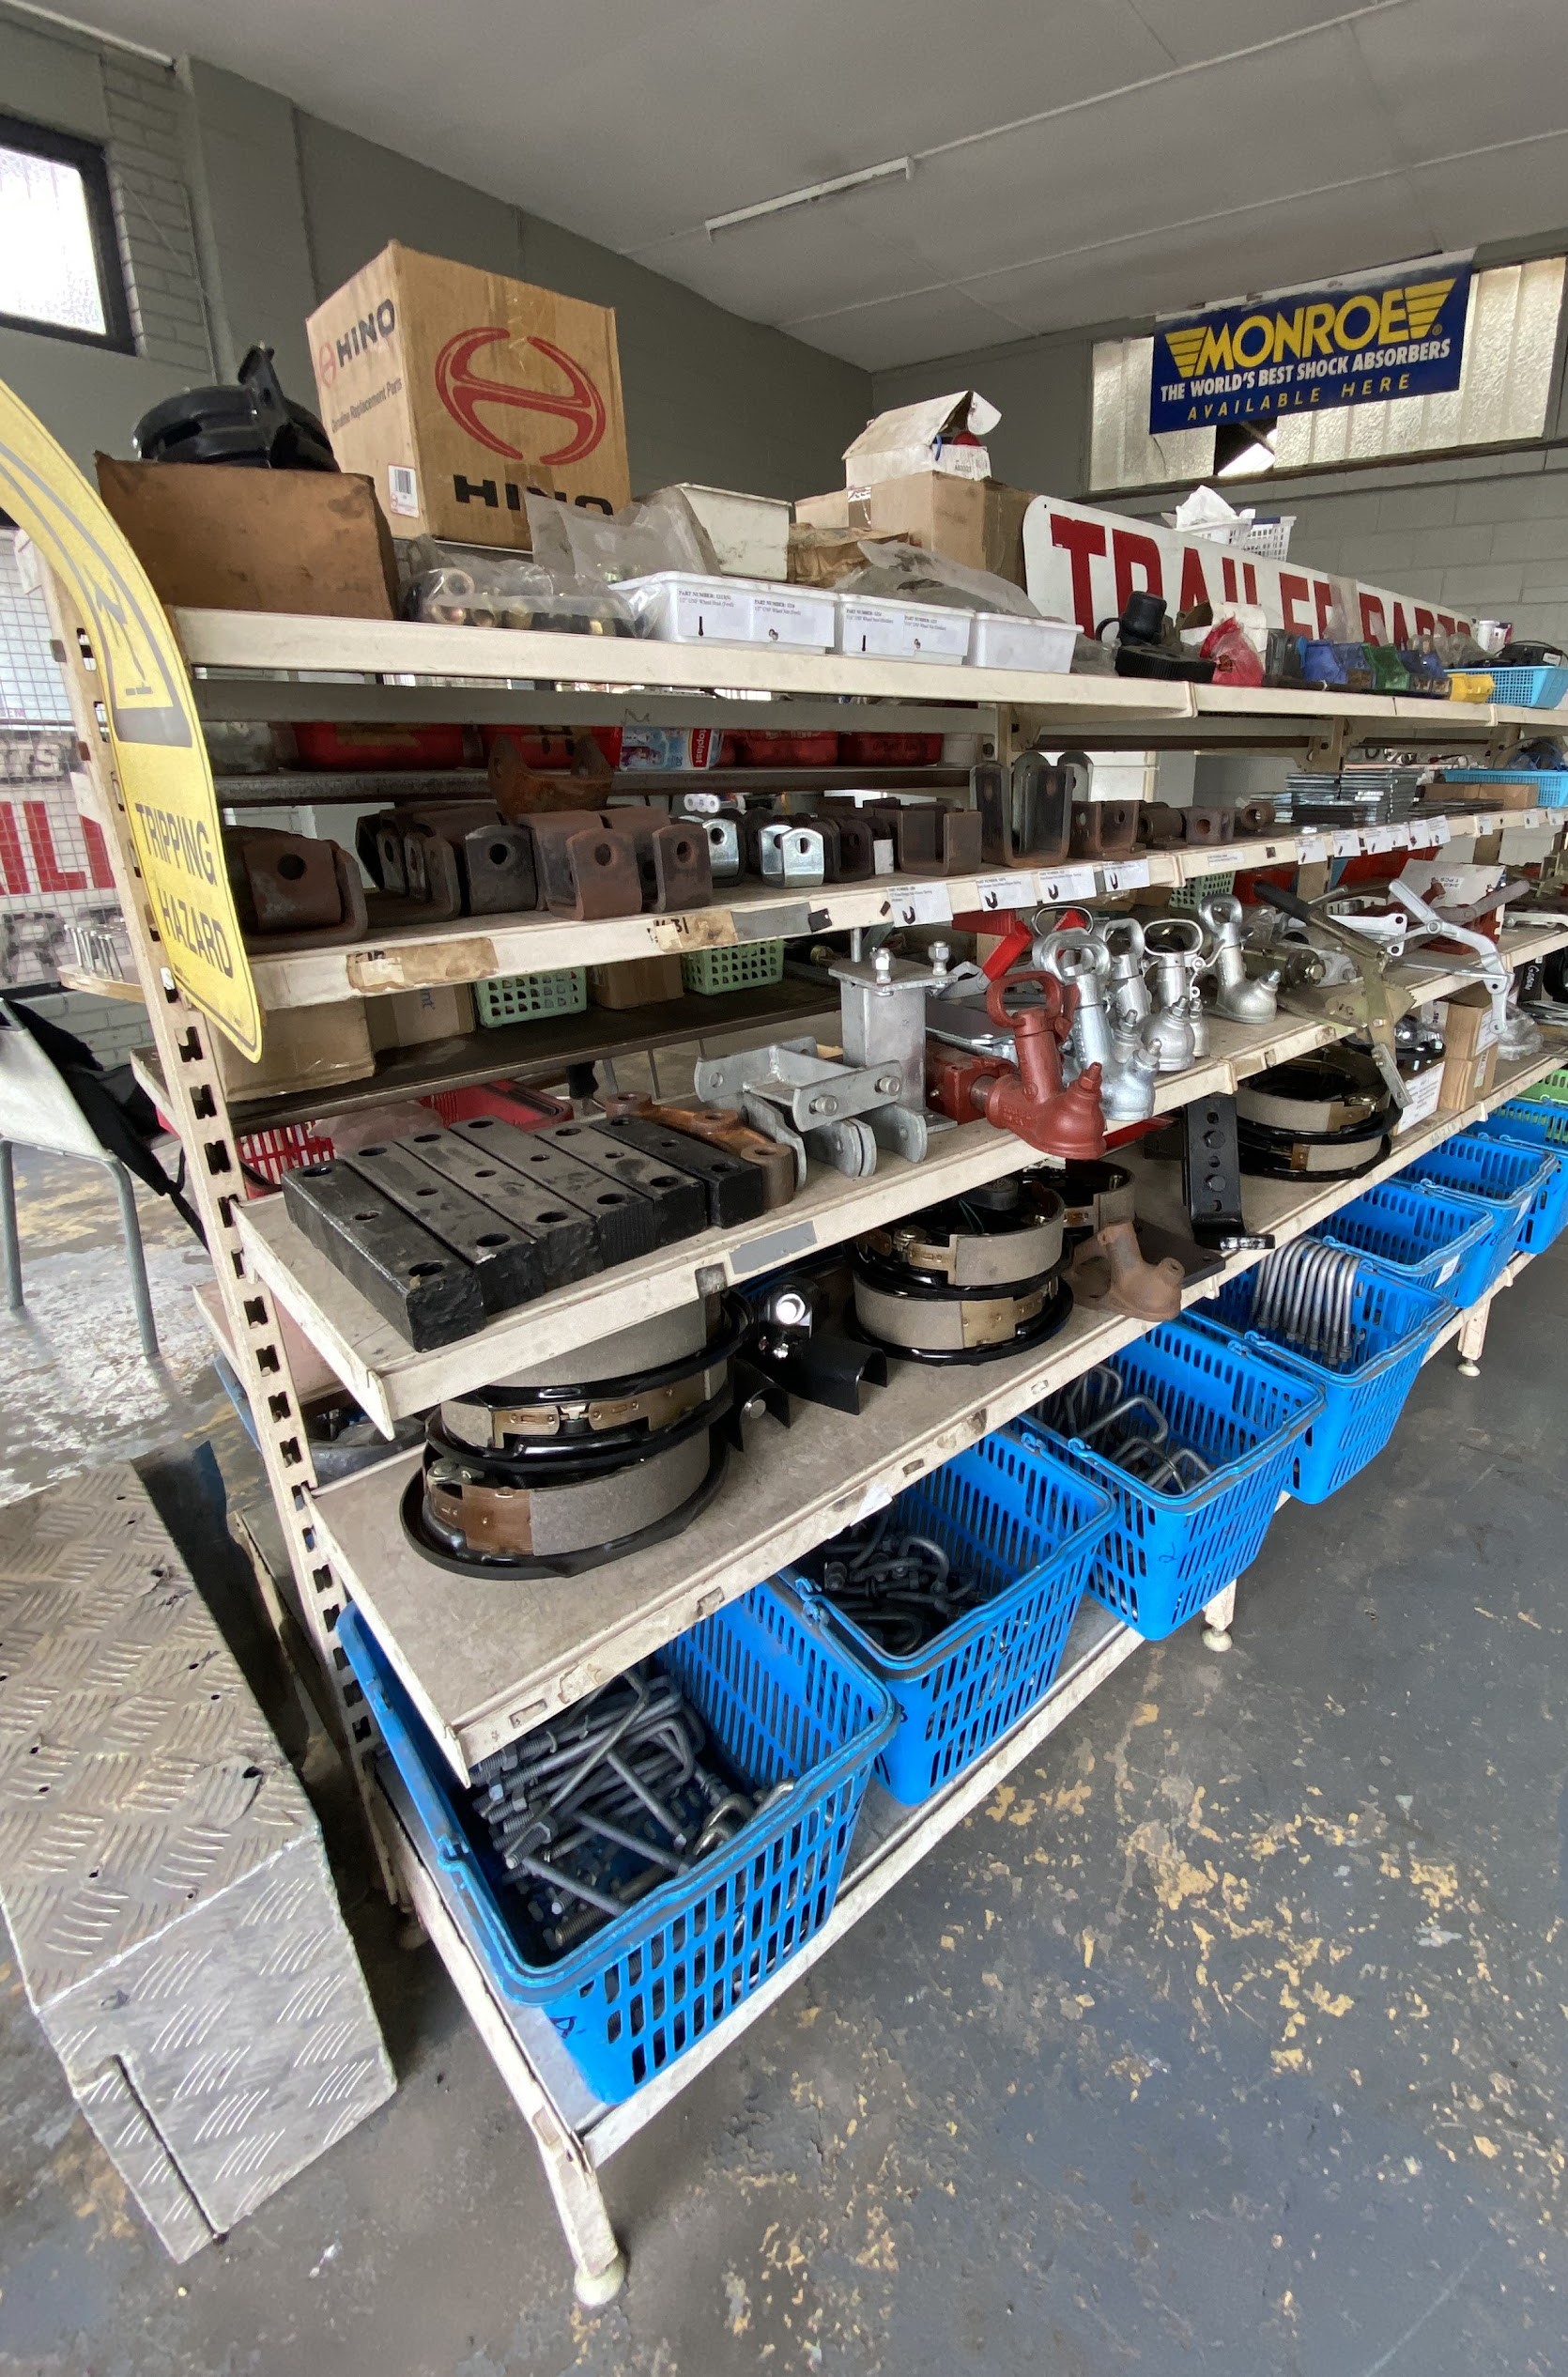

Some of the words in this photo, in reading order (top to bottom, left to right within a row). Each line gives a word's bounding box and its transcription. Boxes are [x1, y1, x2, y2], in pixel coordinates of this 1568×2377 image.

[336, 299, 395, 368] HINO
[1194, 287, 1408, 376] MONROE
[1161, 382, 1185, 403] THE
[1191, 371, 1255, 397] WORLD'S
[1258, 364, 1294, 387] BEST
[1297, 355, 1349, 381] SHOCK
[1351, 338, 1451, 372] ABSORBERS
[1187, 387, 1321, 421] AVAILABLE
[1341, 373, 1410, 398] HERE
[453, 474, 614, 517] HI
[1359, 593, 1471, 652] PAR
[135, 803, 218, 887] TRIPPING
[157, 888, 234, 979] HAZARD
